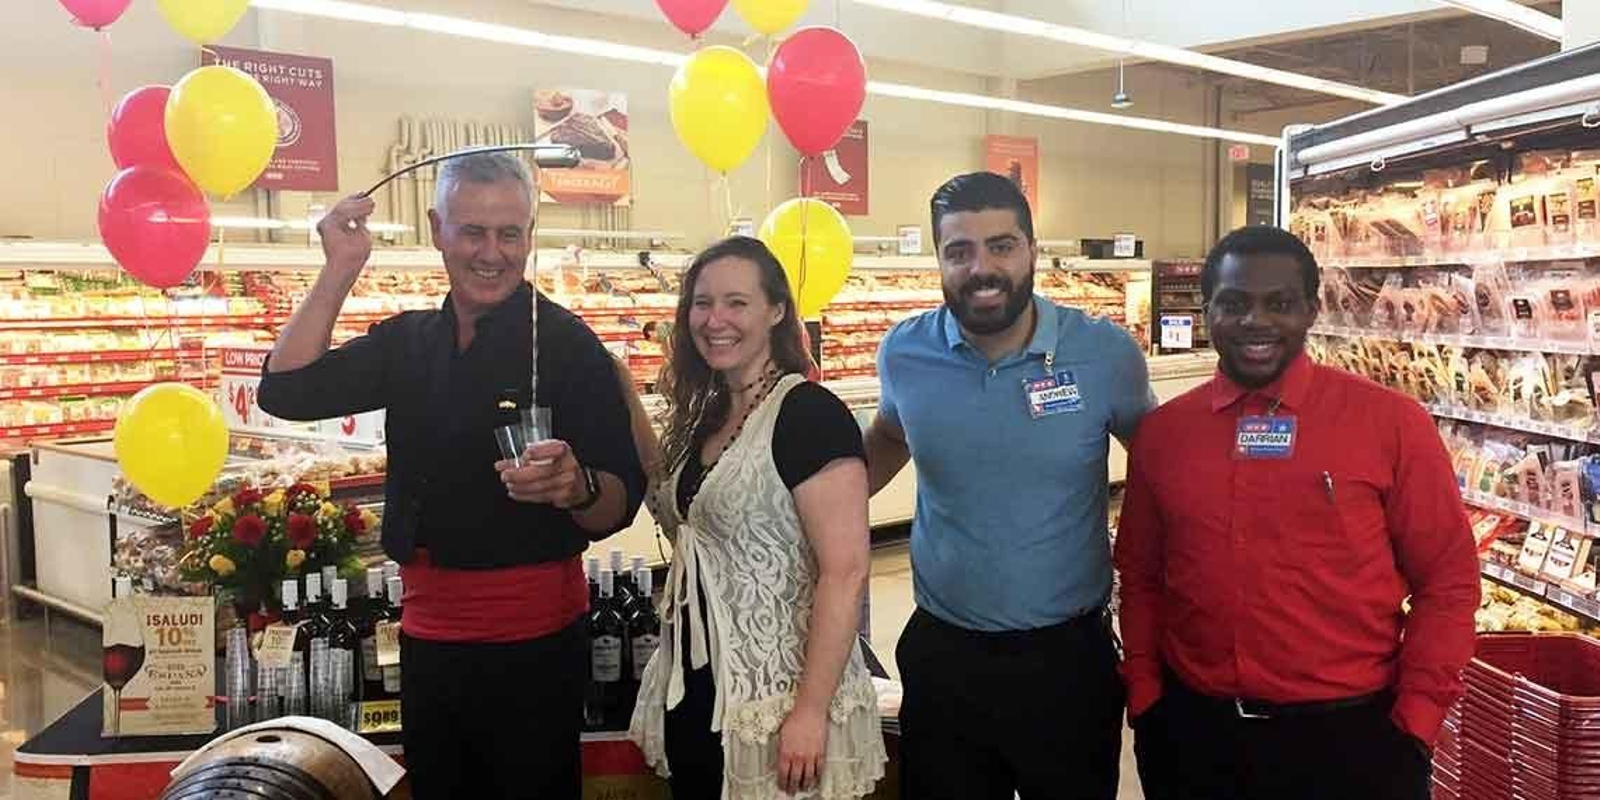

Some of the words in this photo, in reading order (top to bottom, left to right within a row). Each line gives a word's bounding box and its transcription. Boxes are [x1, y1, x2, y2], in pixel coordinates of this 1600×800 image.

[243, 61, 285, 75] RIGHT
[289, 66, 323, 79] CUTS
[263, 76, 295, 86] RIGHT
[299, 79, 323, 88] WAY
[225, 351, 243, 365] LOW
[244, 352, 268, 367] PRIC
[1240, 434, 1289, 444] DARRIAN
[147, 614, 203, 626] ¡SALUD!
